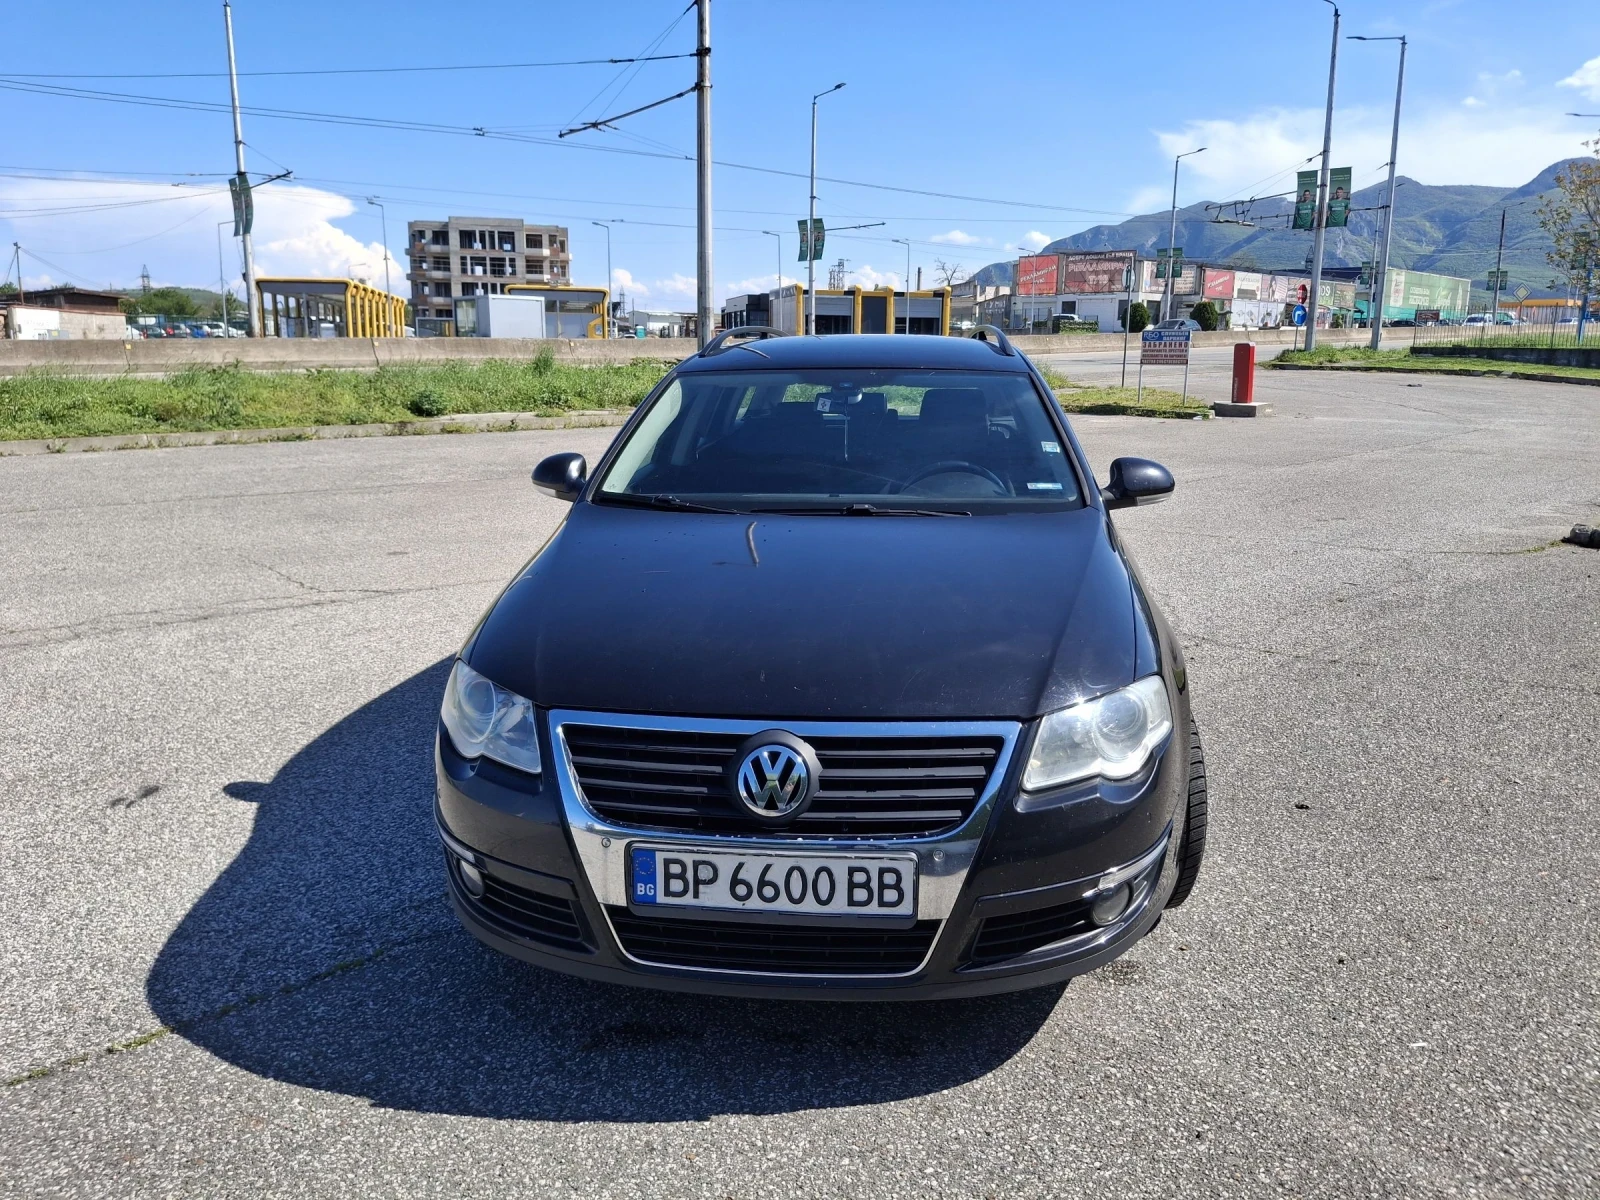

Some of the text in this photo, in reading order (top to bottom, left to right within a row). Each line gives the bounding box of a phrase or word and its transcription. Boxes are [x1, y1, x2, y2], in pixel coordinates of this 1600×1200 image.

[738, 745, 809, 817] VW
[637, 883, 655, 896] BG
[729, 861, 836, 907] 6600
[847, 866, 905, 908] BB
